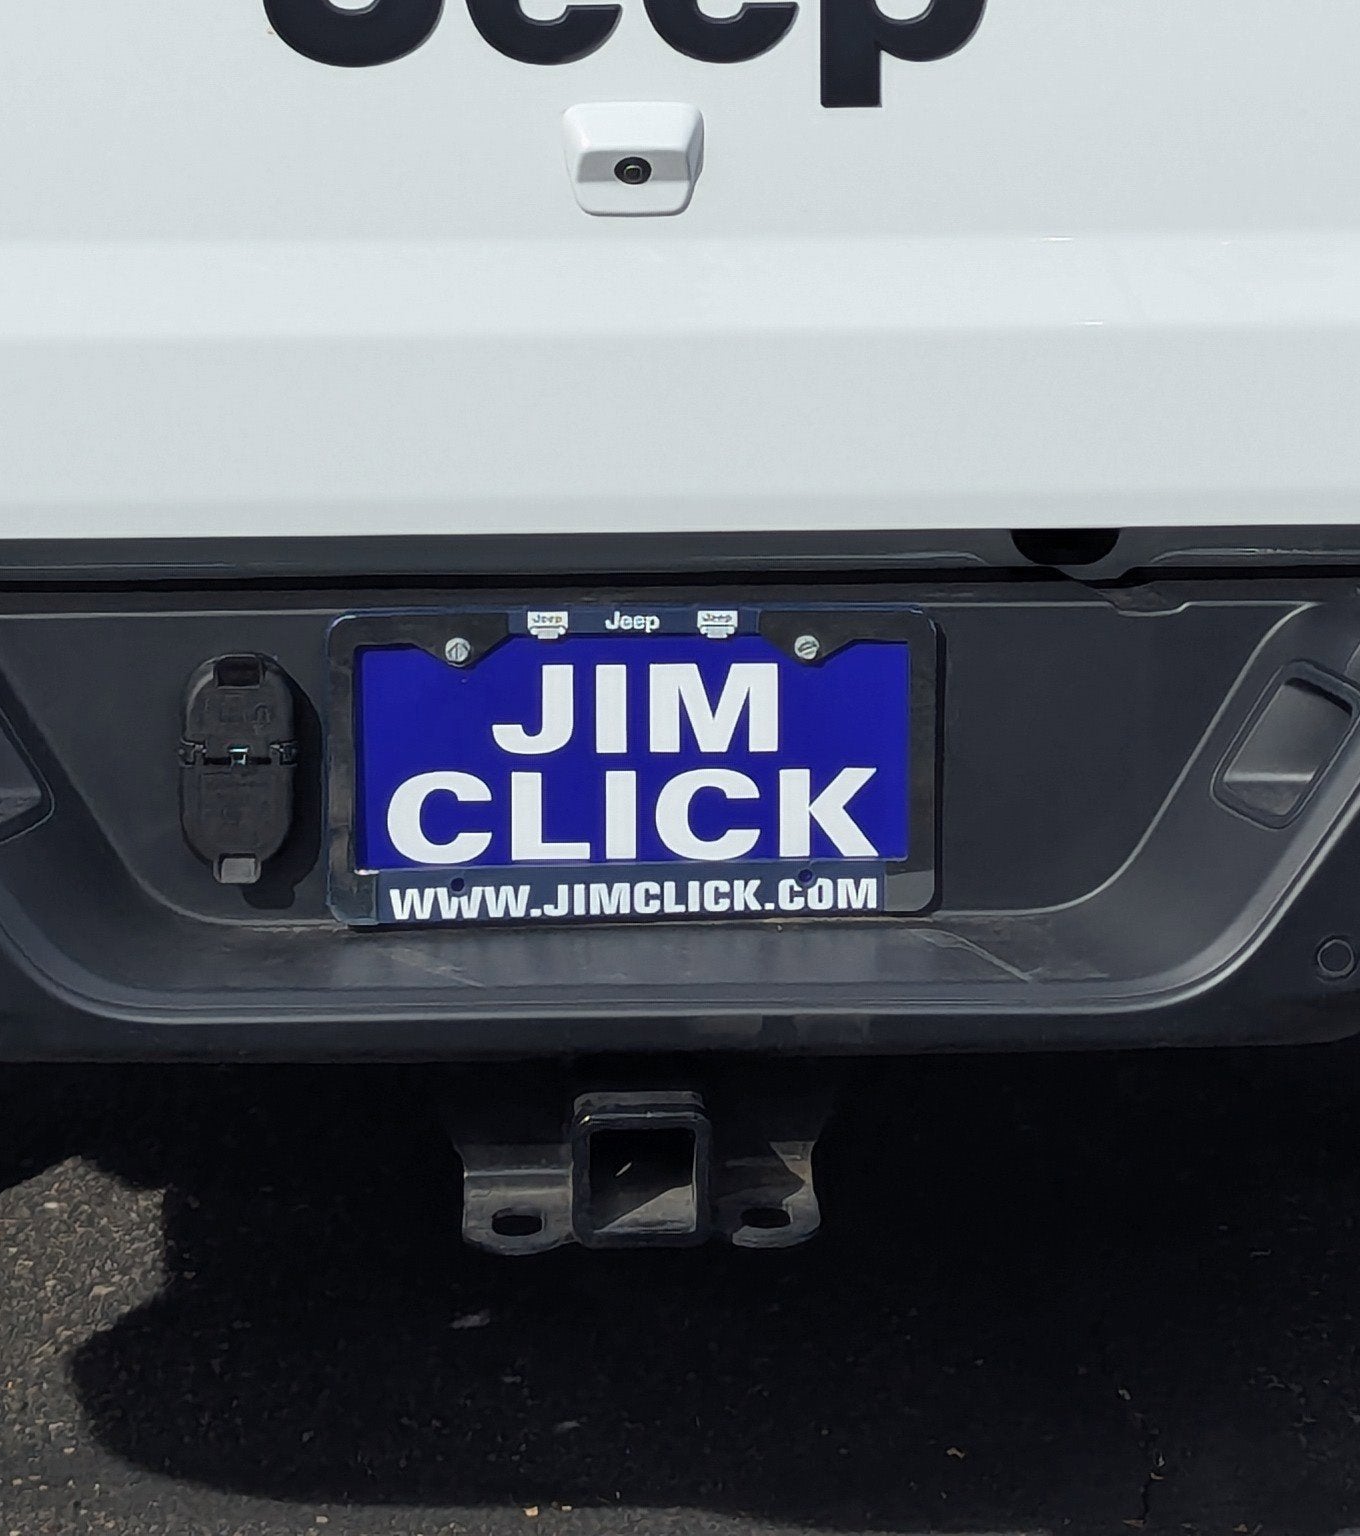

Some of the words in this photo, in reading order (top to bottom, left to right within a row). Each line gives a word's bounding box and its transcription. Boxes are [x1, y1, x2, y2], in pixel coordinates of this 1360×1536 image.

[531, 613, 563, 626] Jeep
[604, 609, 661, 634] Jeep
[491, 662, 780, 756] JIM
[386, 766, 879, 865] CLICK
[390, 877, 878, 921] WWW.JIMCLICK.COM
